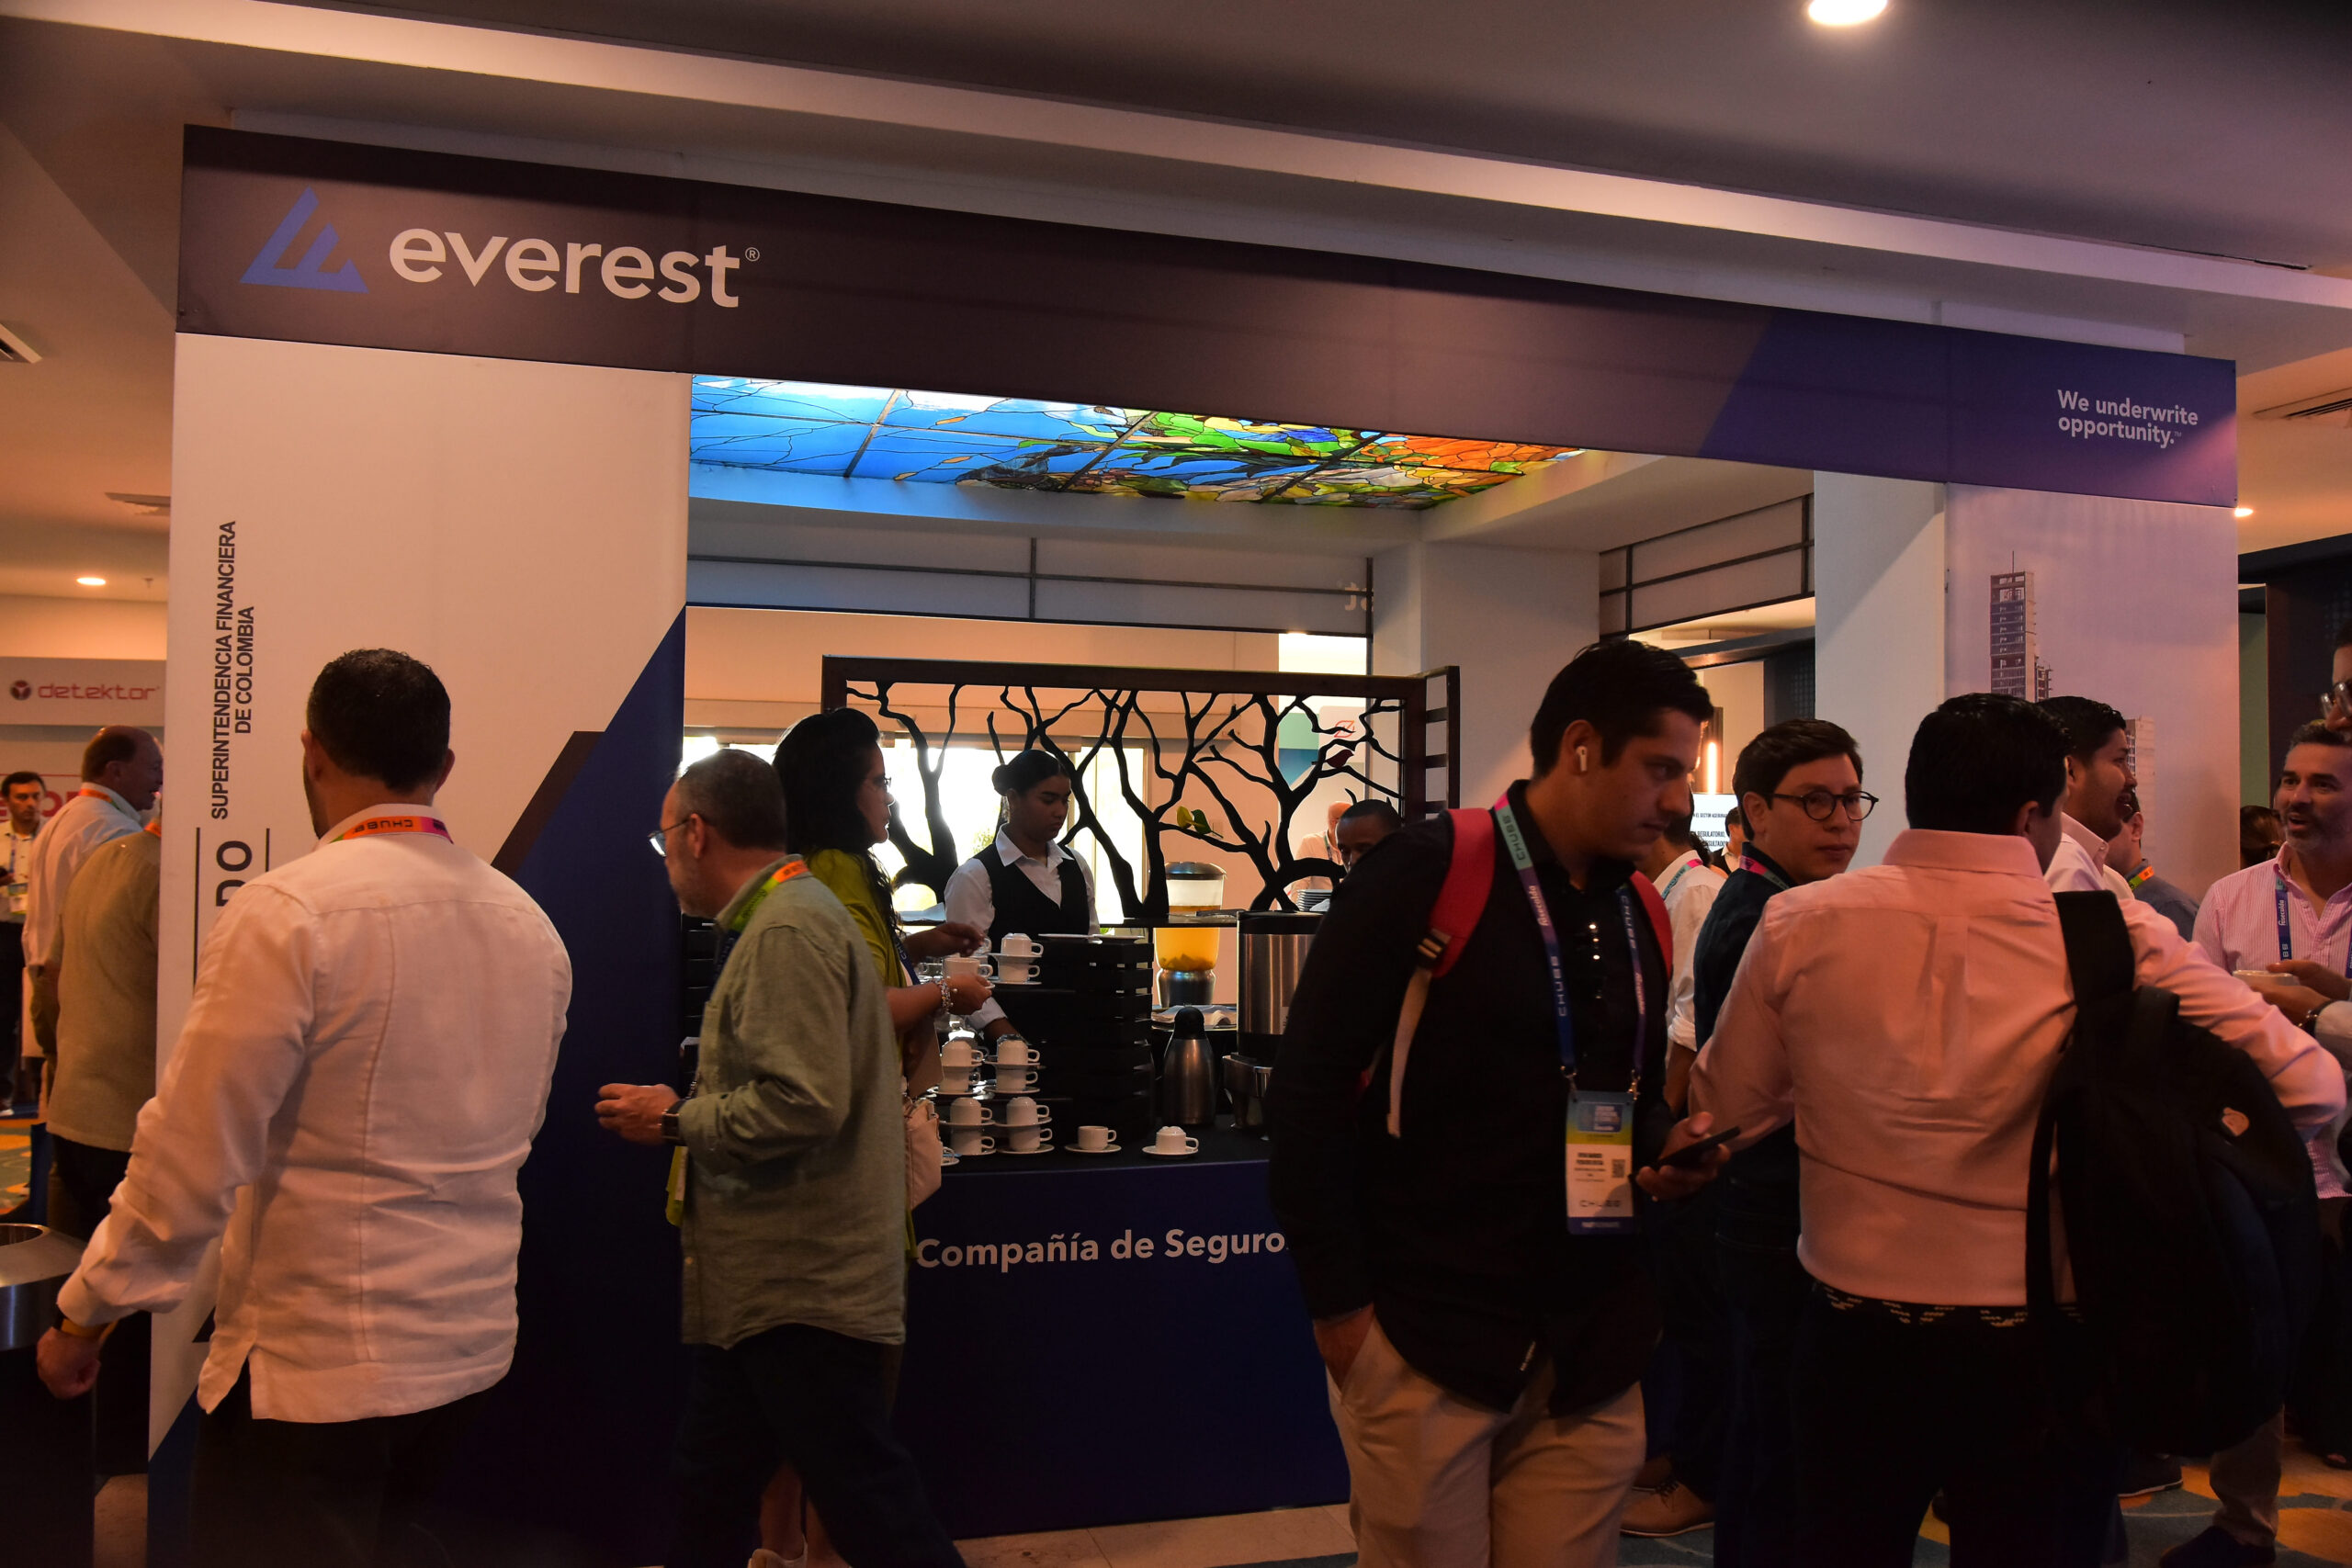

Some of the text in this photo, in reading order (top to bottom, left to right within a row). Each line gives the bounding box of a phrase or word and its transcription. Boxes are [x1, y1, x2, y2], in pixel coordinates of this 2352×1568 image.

[2057, 389, 2199, 426] We underwrite
[211, 520, 236, 820] SUPERINTENDENCIA FINANCIERA
[235, 606, 254, 734] DE COLOMBIA
[38, 683, 156, 700] detektor
[355, 819, 413, 834] CHUBB
[917, 1228, 1288, 1273] Compañía de Seguro
